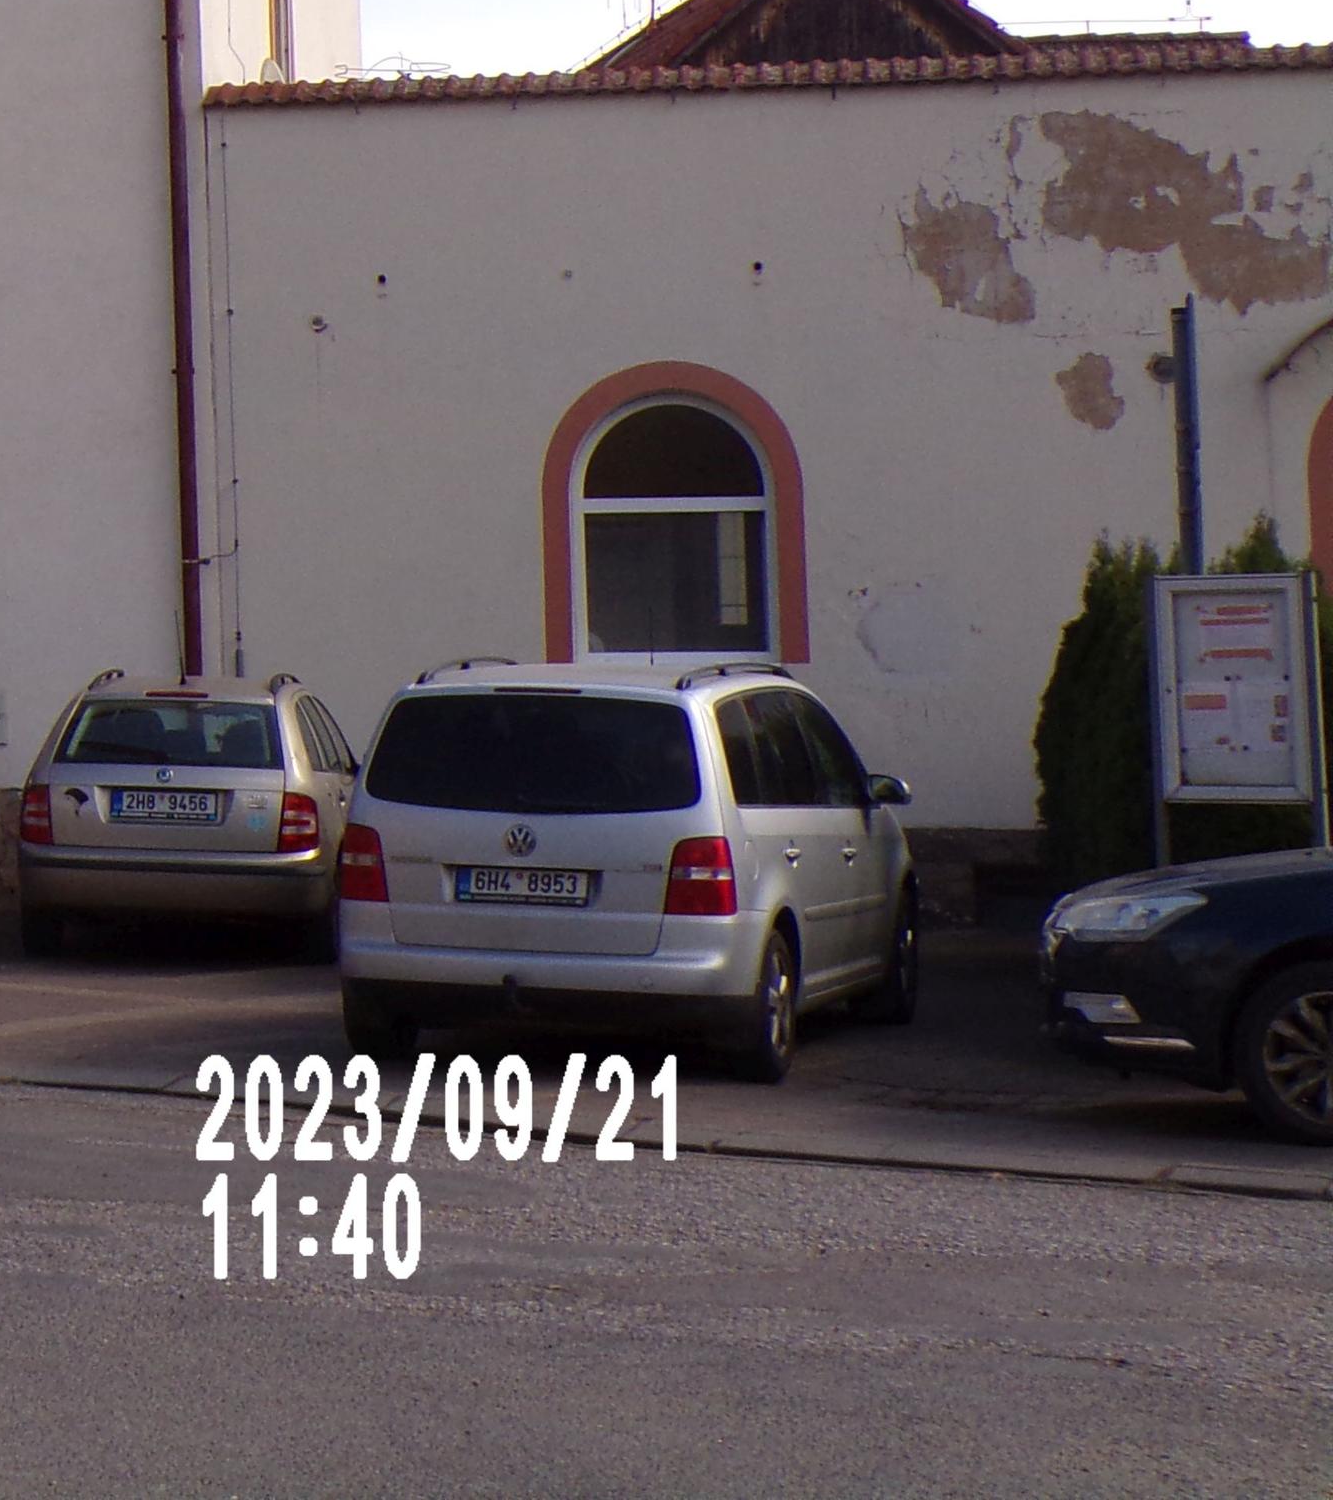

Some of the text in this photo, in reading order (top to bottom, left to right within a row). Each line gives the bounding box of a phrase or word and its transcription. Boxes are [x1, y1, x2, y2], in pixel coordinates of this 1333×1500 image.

[126, 794, 208, 812] 2H8 9456
[474, 871, 578, 893] 6H4 8953
